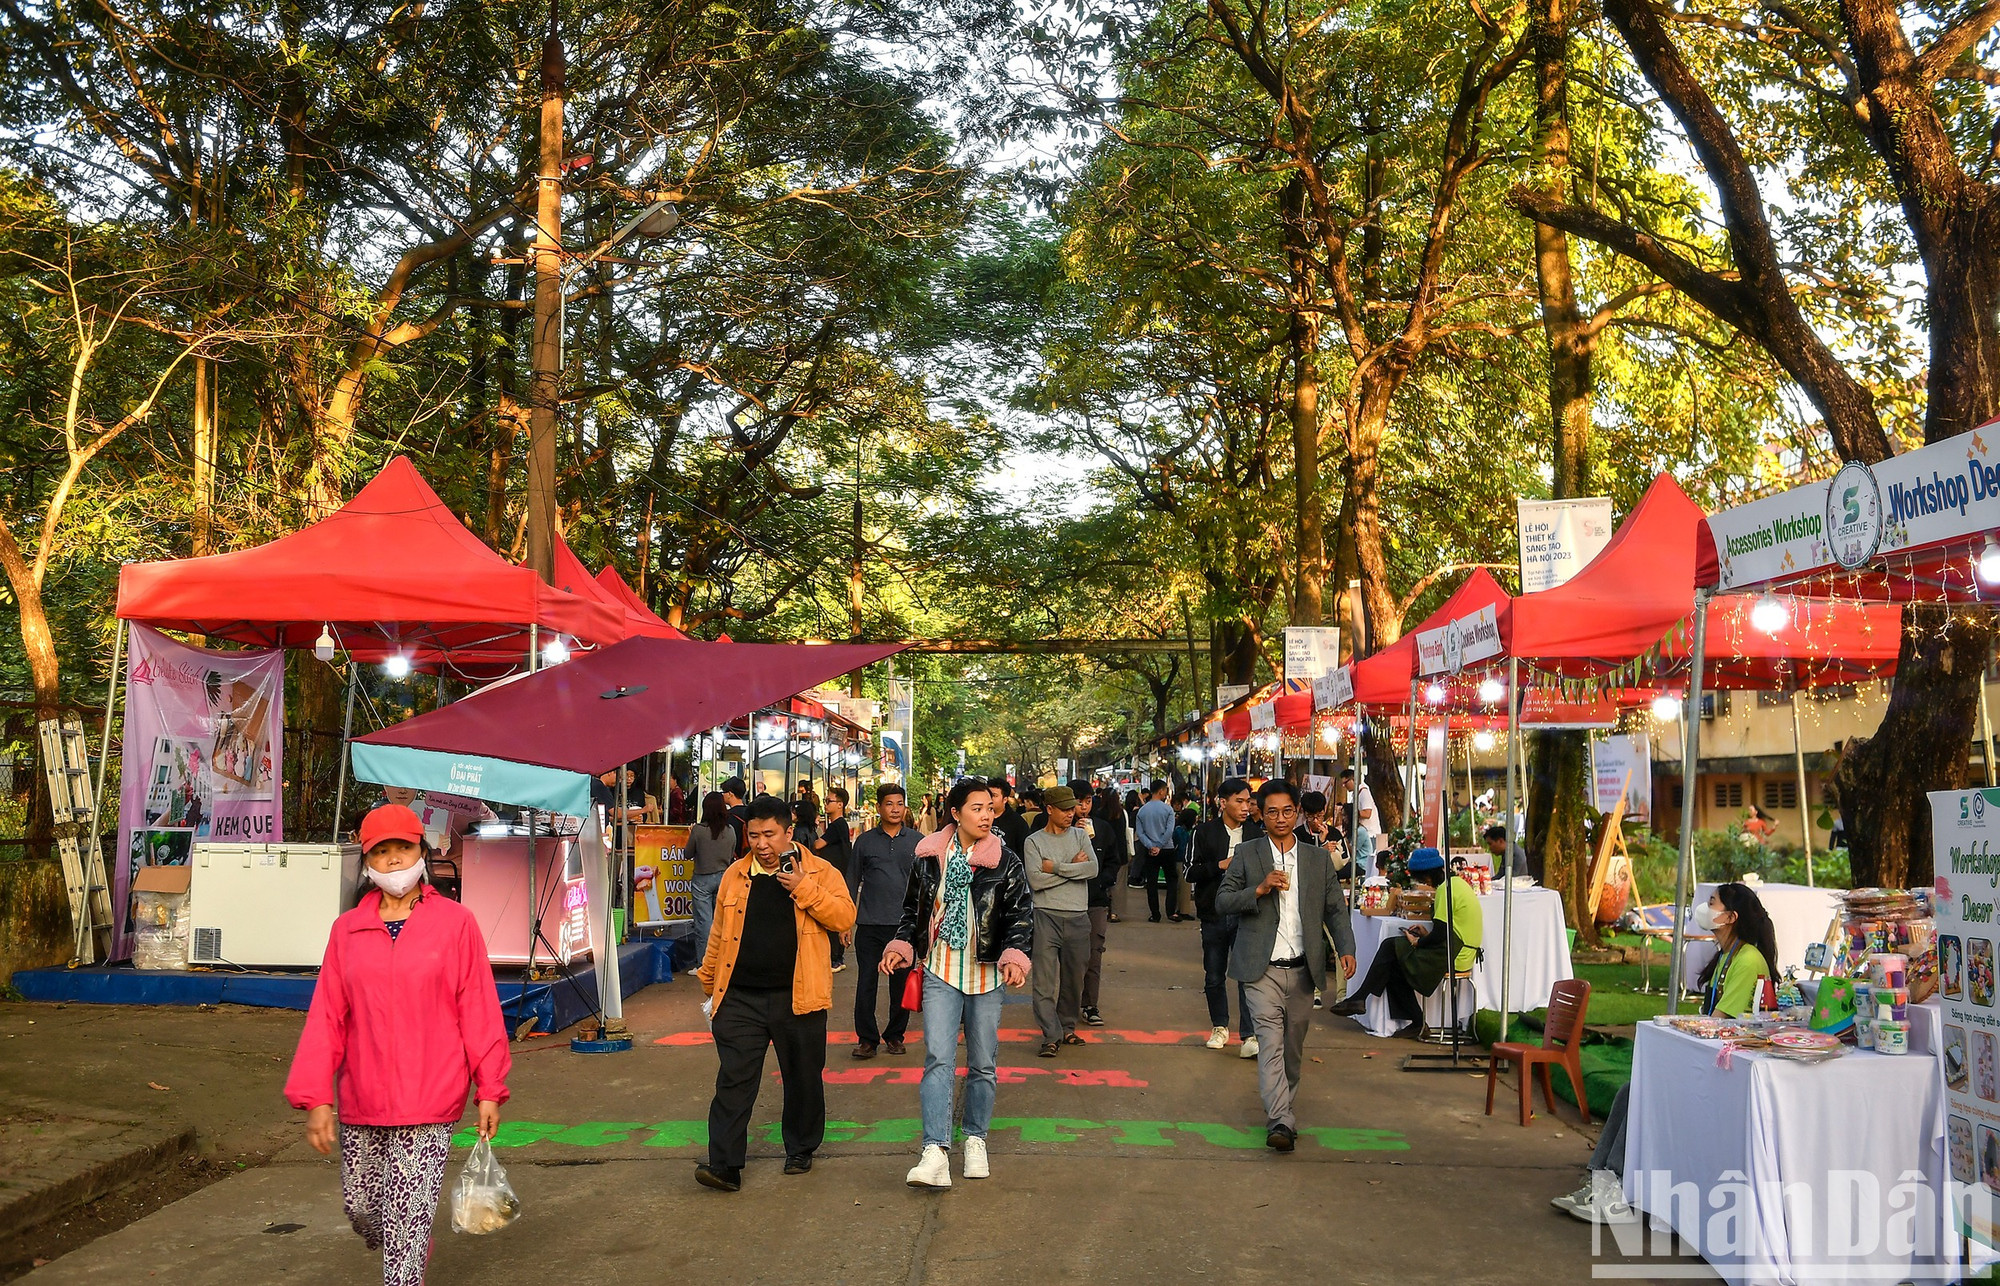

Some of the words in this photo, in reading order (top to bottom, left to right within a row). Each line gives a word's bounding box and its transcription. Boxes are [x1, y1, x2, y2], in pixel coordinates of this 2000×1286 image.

[1888, 470, 1969, 523] Workshop
[1725, 524, 1773, 558] Accessories
[1772, 512, 1822, 544] Workshop
[1838, 521, 1868, 537] CREATIVE
[1553, 551, 1572, 561] 2023
[215, 815, 240, 837] KEM
[242, 815, 273, 839] QUE
[661, 844, 694, 861] BÁN
[672, 863, 684, 876] 10
[1950, 840, 2000, 889] Workshop
[664, 880, 692, 893] WON
[663, 895, 693, 916] 30k
[1961, 893, 1993, 924] Decor
